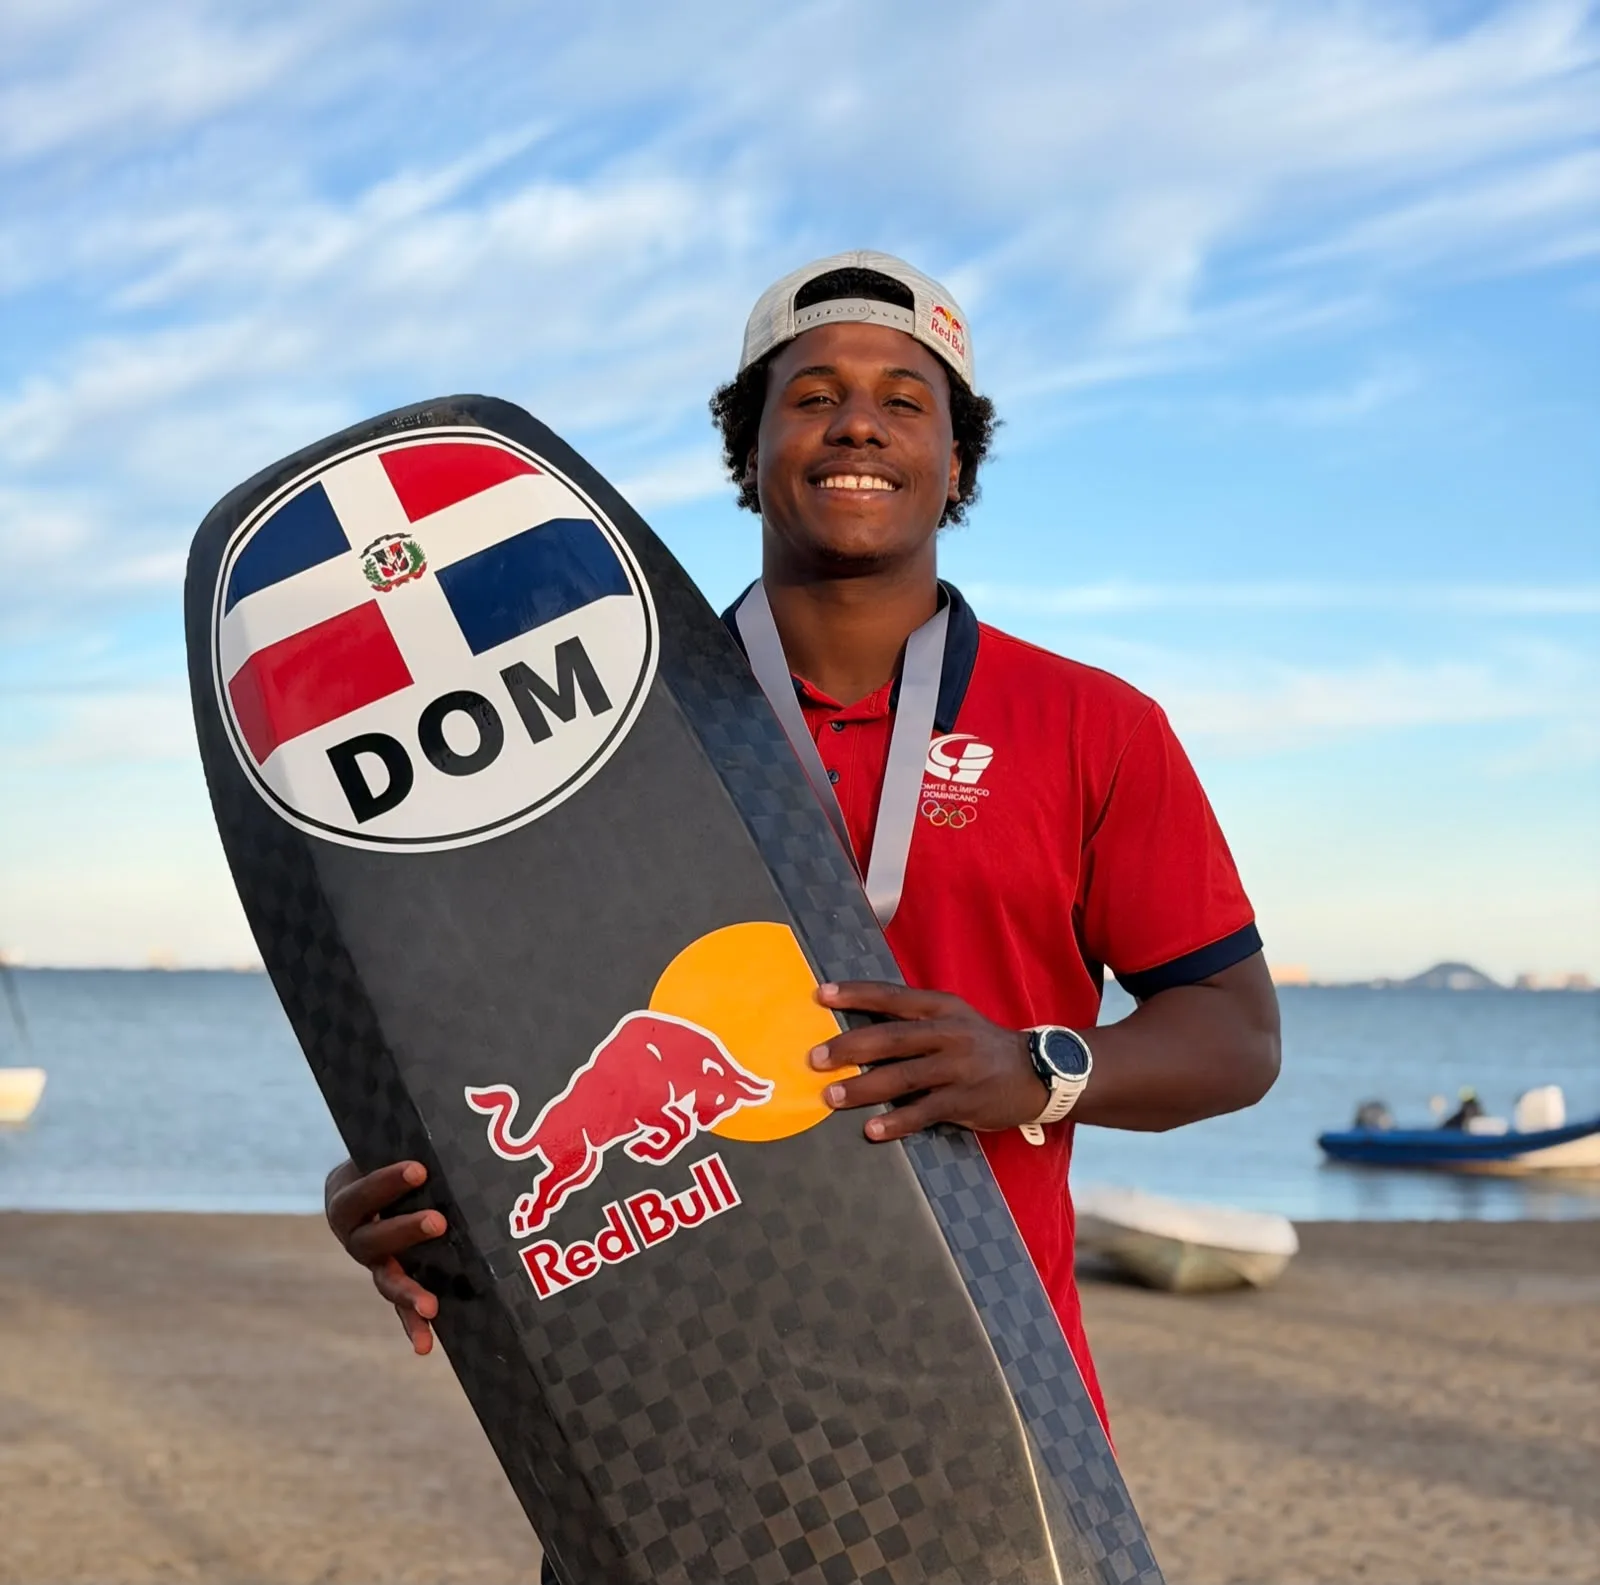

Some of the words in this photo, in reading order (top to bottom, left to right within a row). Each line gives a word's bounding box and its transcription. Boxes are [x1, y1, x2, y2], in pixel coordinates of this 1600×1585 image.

[931, 318, 951, 342] Red
[326, 636, 613, 824] DOM
[921, 783, 946, 791] OMITÉ
[949, 785, 989, 797] OLÍMPICO
[923, 791, 978, 803] DOMINICANO
[520, 1203, 639, 1299] Red
[625, 1154, 740, 1247] Bull
